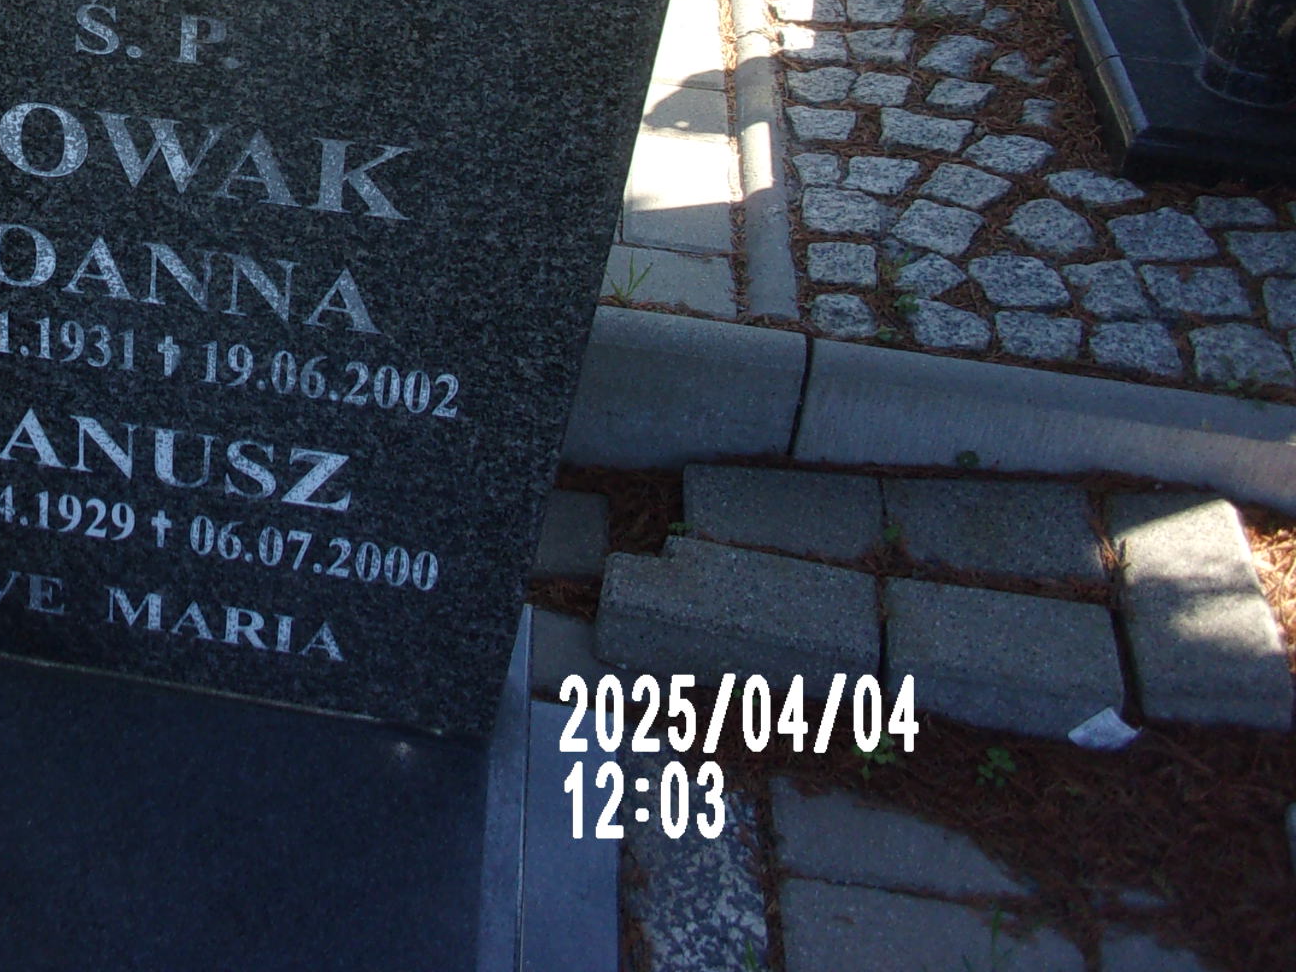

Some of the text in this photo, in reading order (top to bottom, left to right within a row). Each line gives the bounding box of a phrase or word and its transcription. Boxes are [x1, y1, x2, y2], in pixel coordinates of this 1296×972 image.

[178, 14, 241, 70] P.
[204, 339, 459, 419] 19.06.2002
[189, 515, 440, 592] 06.07.2000
[106, 585, 344, 663] MARIA
